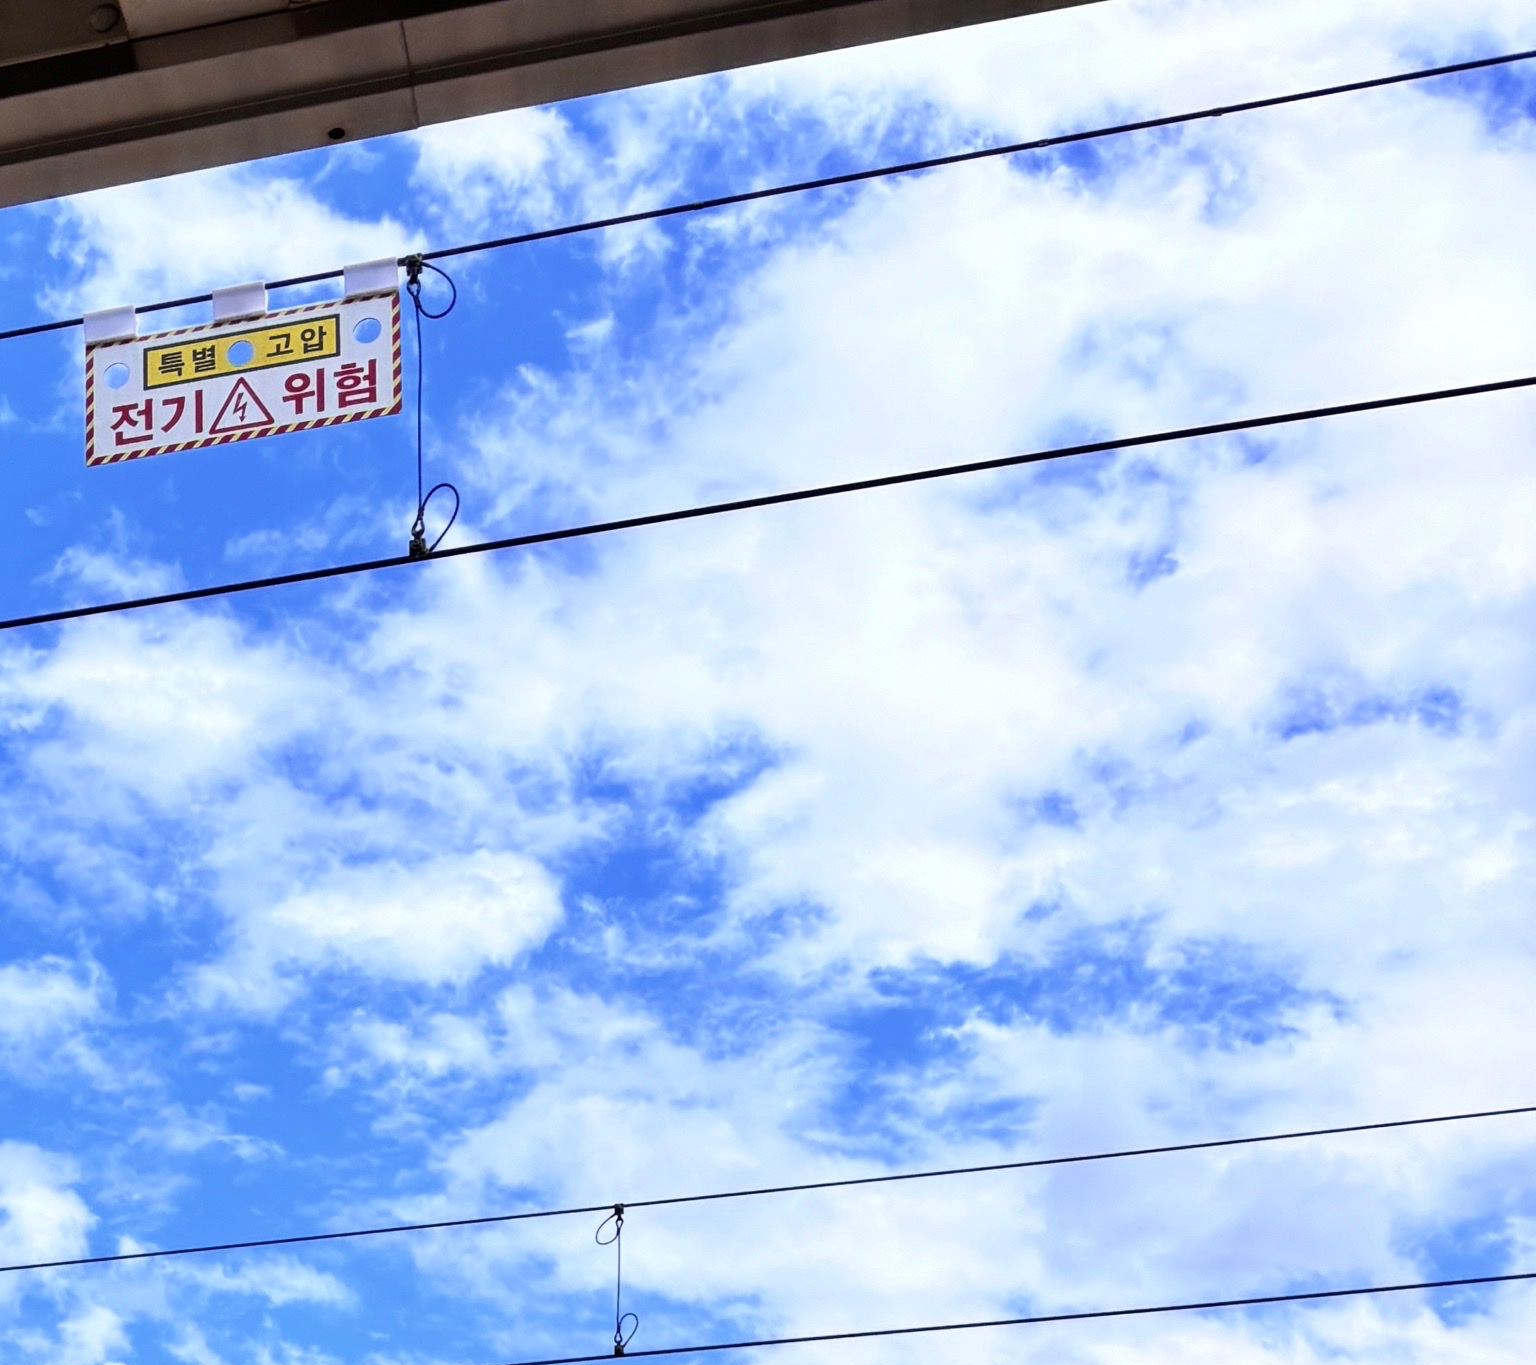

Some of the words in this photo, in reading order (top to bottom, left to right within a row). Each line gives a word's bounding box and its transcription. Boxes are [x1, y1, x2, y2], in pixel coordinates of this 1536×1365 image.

[158, 344, 217, 377] 특별
[266, 326, 328, 358] 고압
[110, 390, 204, 447] 전기
[282, 358, 378, 416] 위험
